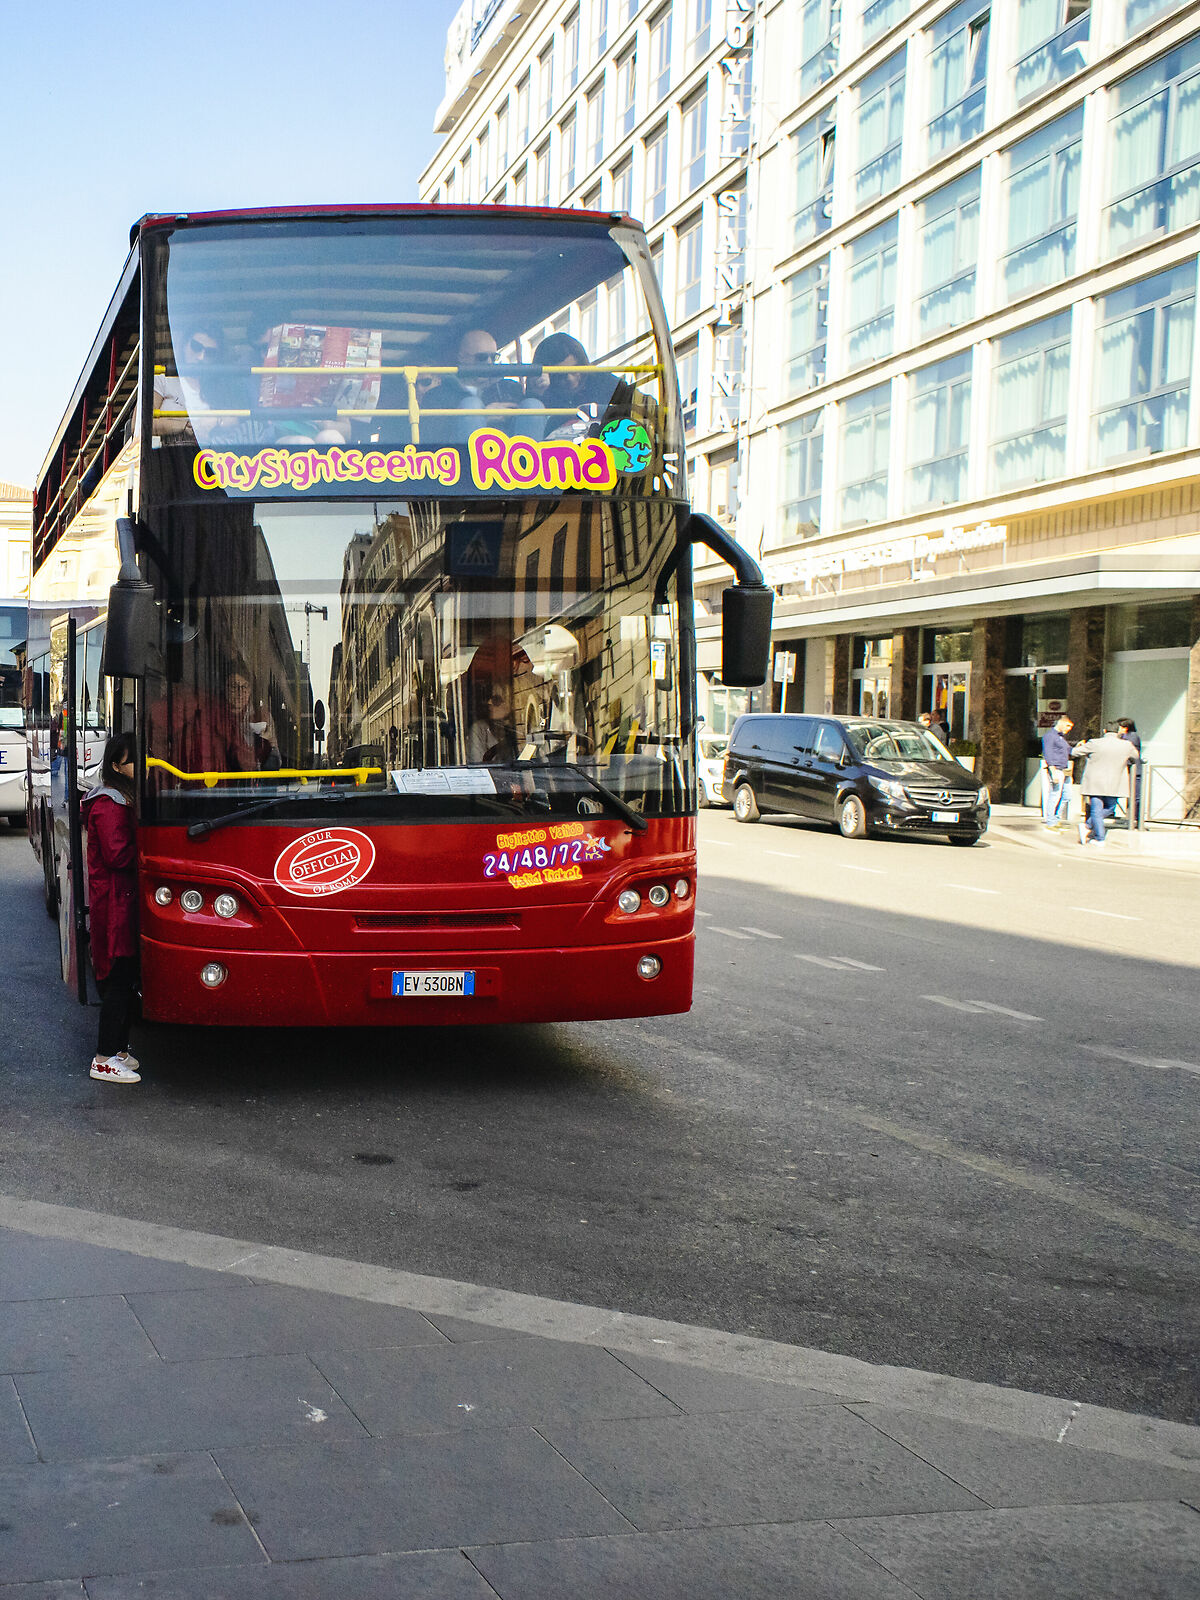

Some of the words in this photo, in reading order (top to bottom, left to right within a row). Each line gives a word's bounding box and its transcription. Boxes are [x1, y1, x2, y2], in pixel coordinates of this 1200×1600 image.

[709, 190, 742, 433] SANTINA
[468, 428, 617, 491] Roma
[299, 832, 333, 847] TOUR
[497, 830, 546, 849] Biglietto
[549, 823, 584, 839] Valido
[292, 849, 357, 878] OFFICIAL
[484, 840, 582, 876] 24/48/72
[313, 885, 328, 894] OF
[329, 875, 358, 891] ROMA
[508, 872, 543, 889] Valid
[542, 866, 583, 882] Ticket
